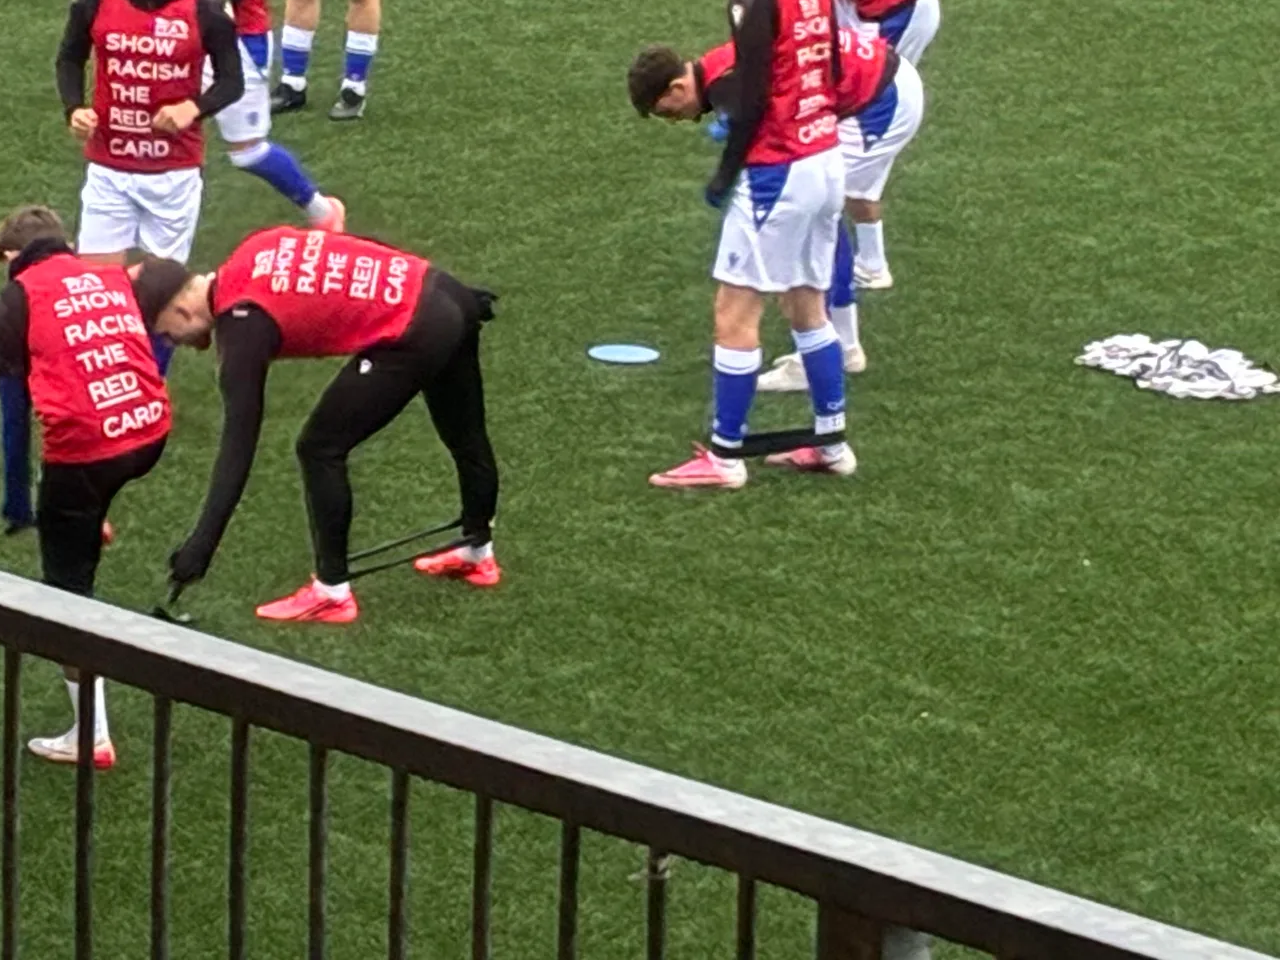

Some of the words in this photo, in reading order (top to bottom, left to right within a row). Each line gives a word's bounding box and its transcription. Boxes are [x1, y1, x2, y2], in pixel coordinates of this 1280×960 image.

[104, 32, 178, 58] SHOW
[107, 57, 191, 82] RACISM
[109, 82, 151, 105] THE
[109, 106, 152, 129] RED
[109, 138, 171, 159] CARD
[270, 236, 299, 294] SHOW
[295, 229, 326, 295] RACIS
[322, 251, 349, 296] THE
[349, 255, 376, 301] RED
[384, 255, 410, 306] CARD
[53, 290, 128, 319] SHOW
[75, 341, 130, 373] THE
[87, 371, 140, 404] RED
[103, 400, 165, 439] CARD
